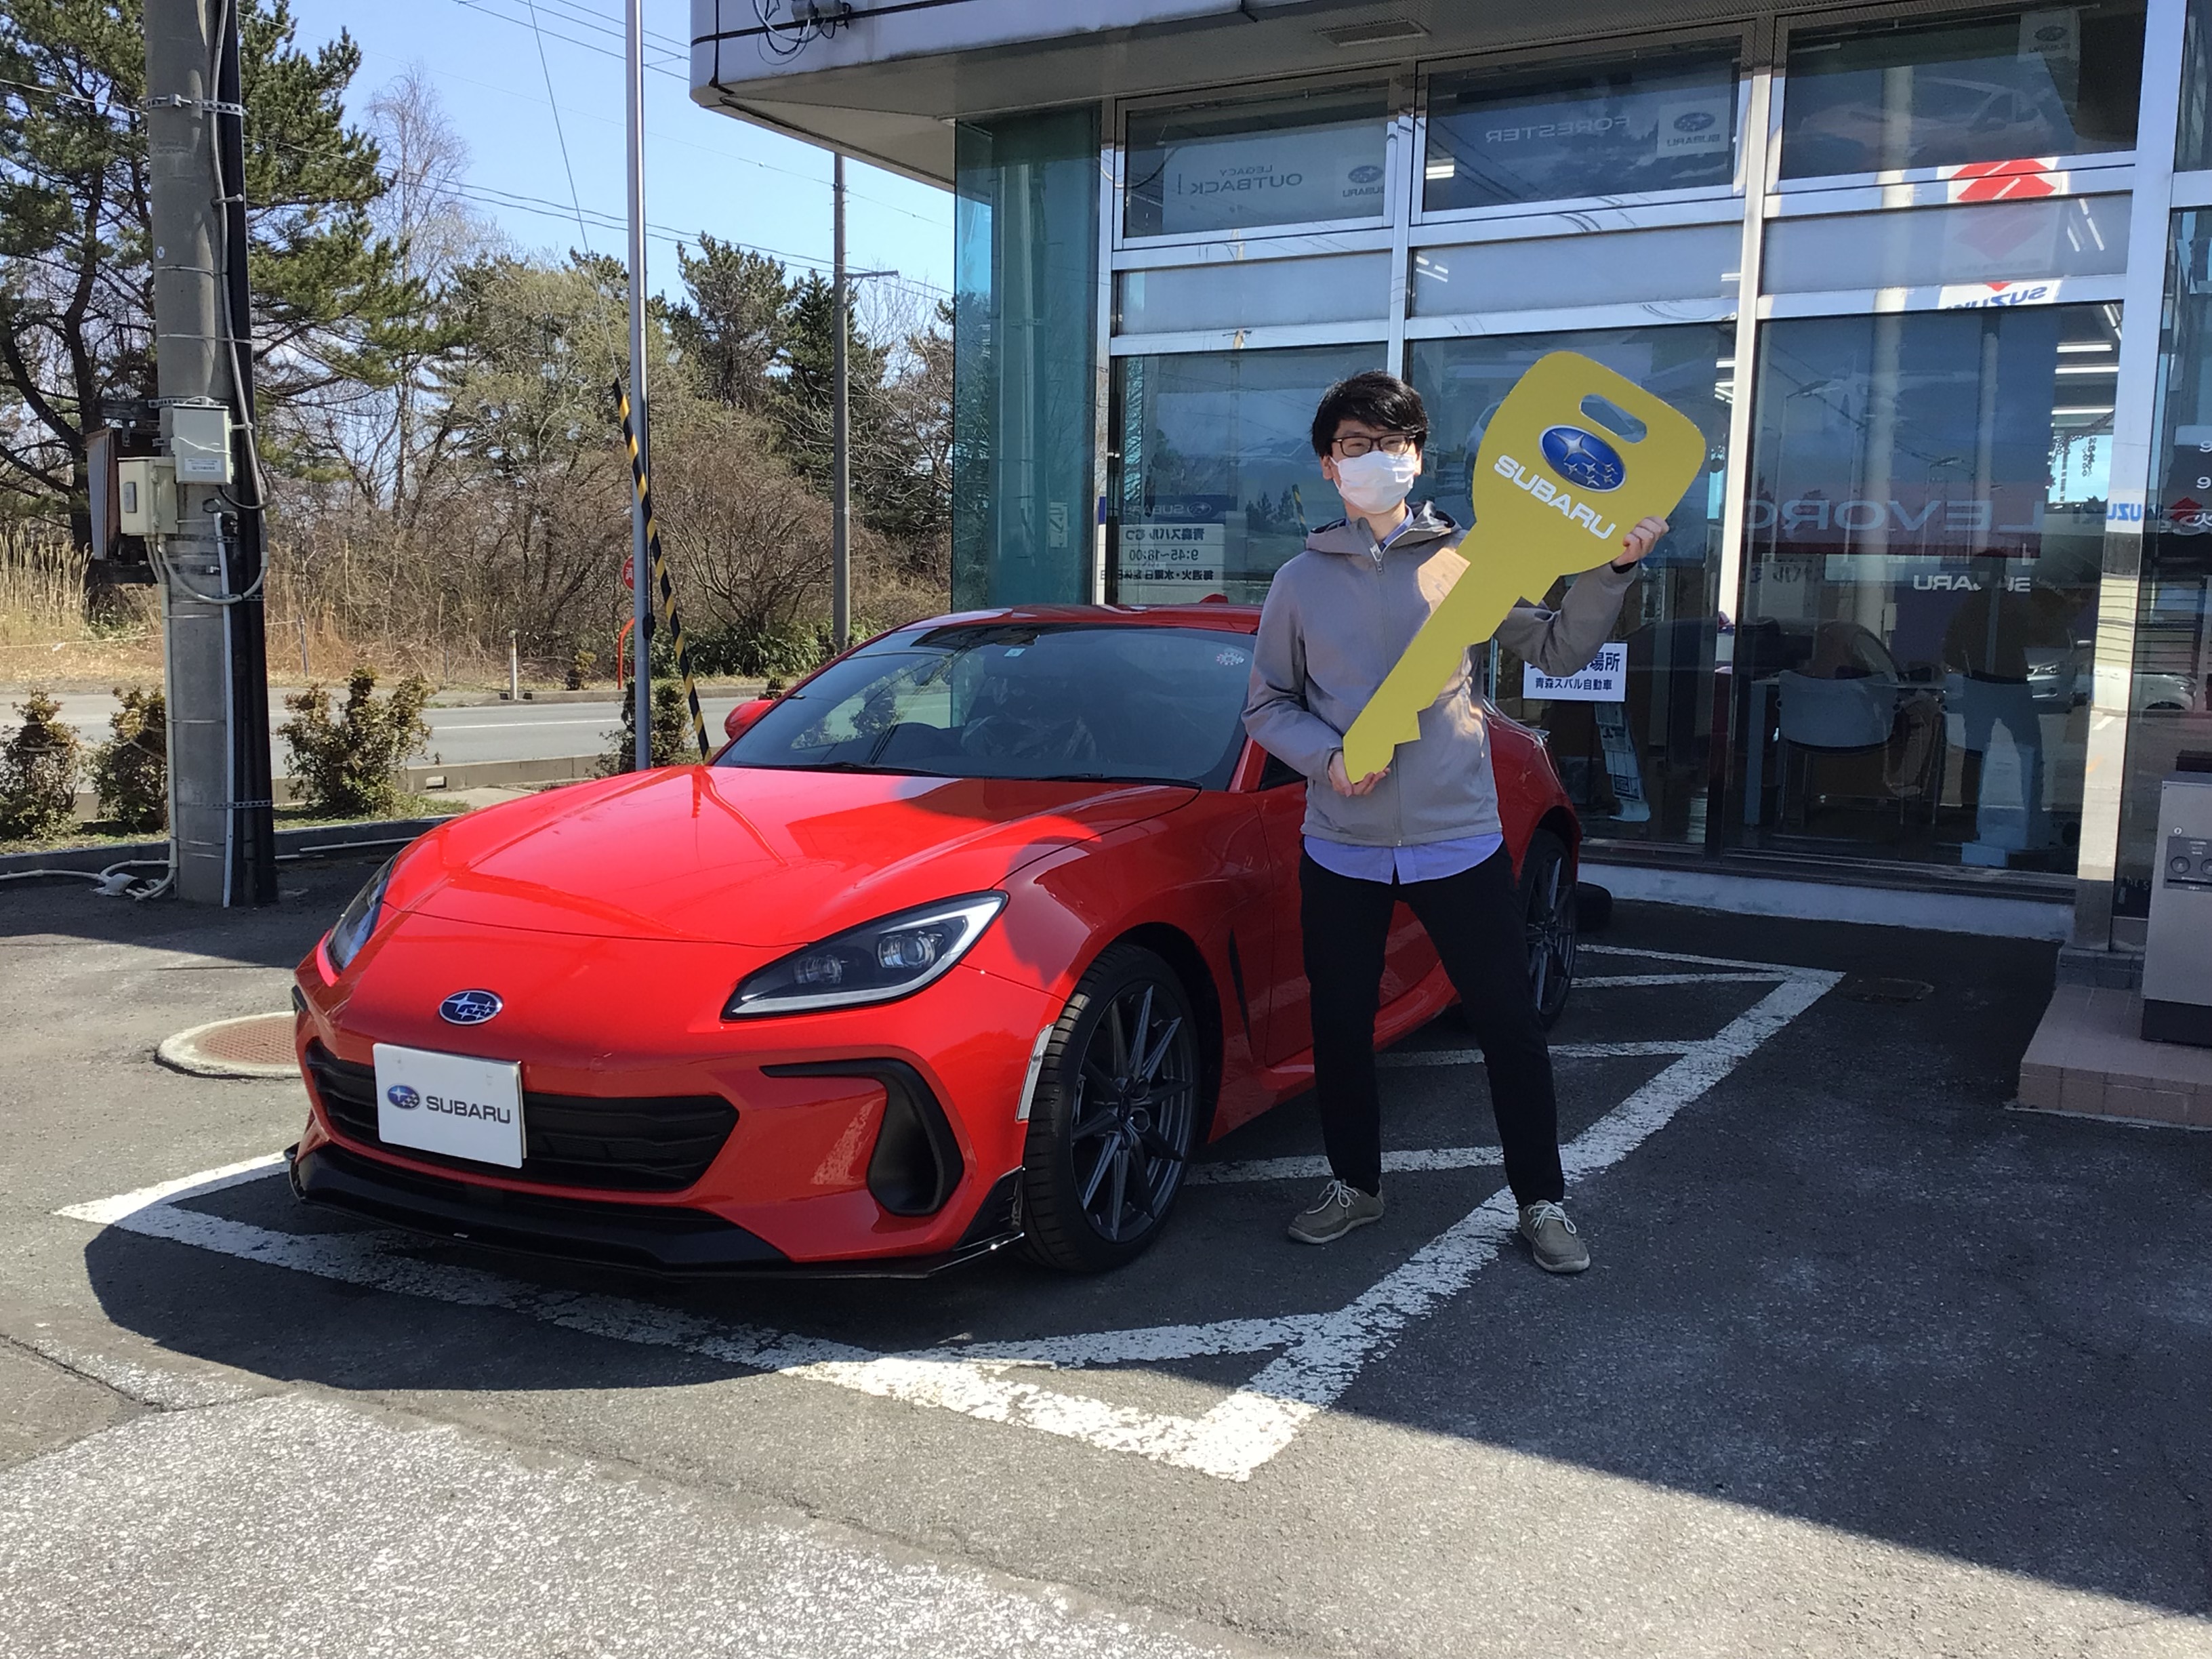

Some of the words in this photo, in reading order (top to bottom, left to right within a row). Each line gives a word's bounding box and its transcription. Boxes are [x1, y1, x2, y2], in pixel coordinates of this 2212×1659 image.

[1494, 455, 1616, 539] SUBARU
[1535, 677, 1613, 691] 青森スバル自動車
[426, 1095, 510, 1124] SUBARU
